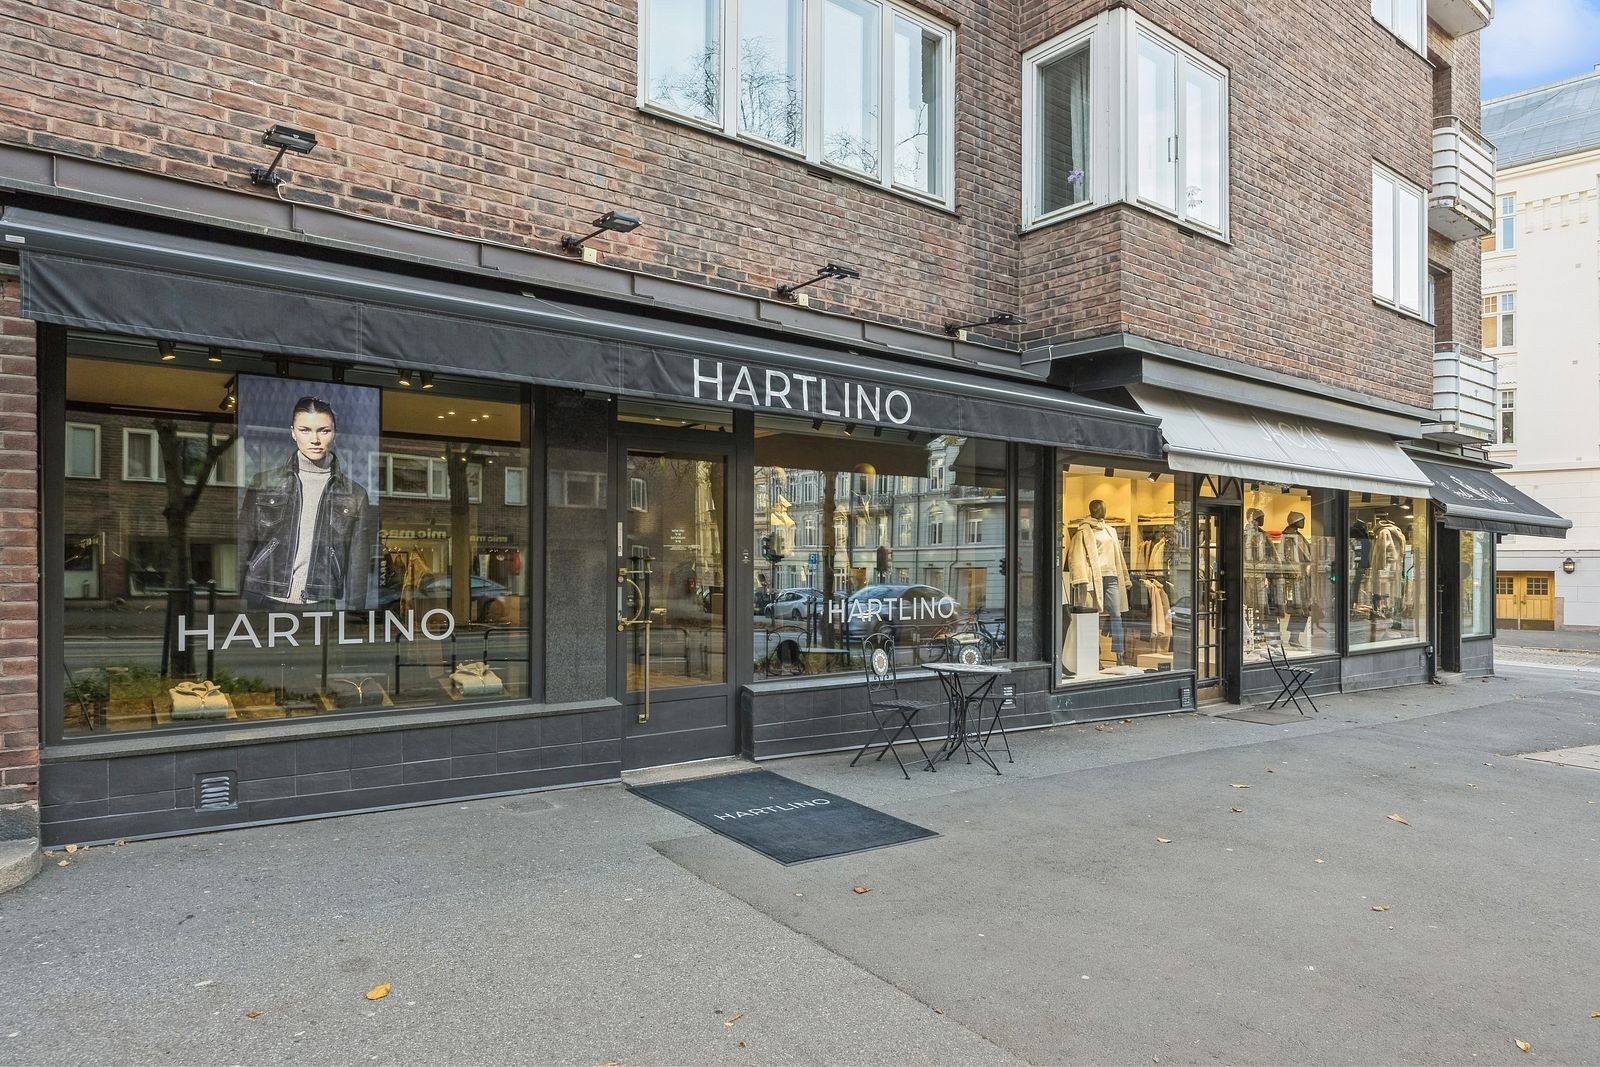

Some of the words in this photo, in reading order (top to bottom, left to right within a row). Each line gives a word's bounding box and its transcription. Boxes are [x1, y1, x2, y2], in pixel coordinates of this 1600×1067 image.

[693, 358, 912, 425] HARTLINO
[827, 596, 955, 624] HARTLINO
[178, 608, 455, 651] HARTLINO
[714, 798, 831, 821] HARTLINO
